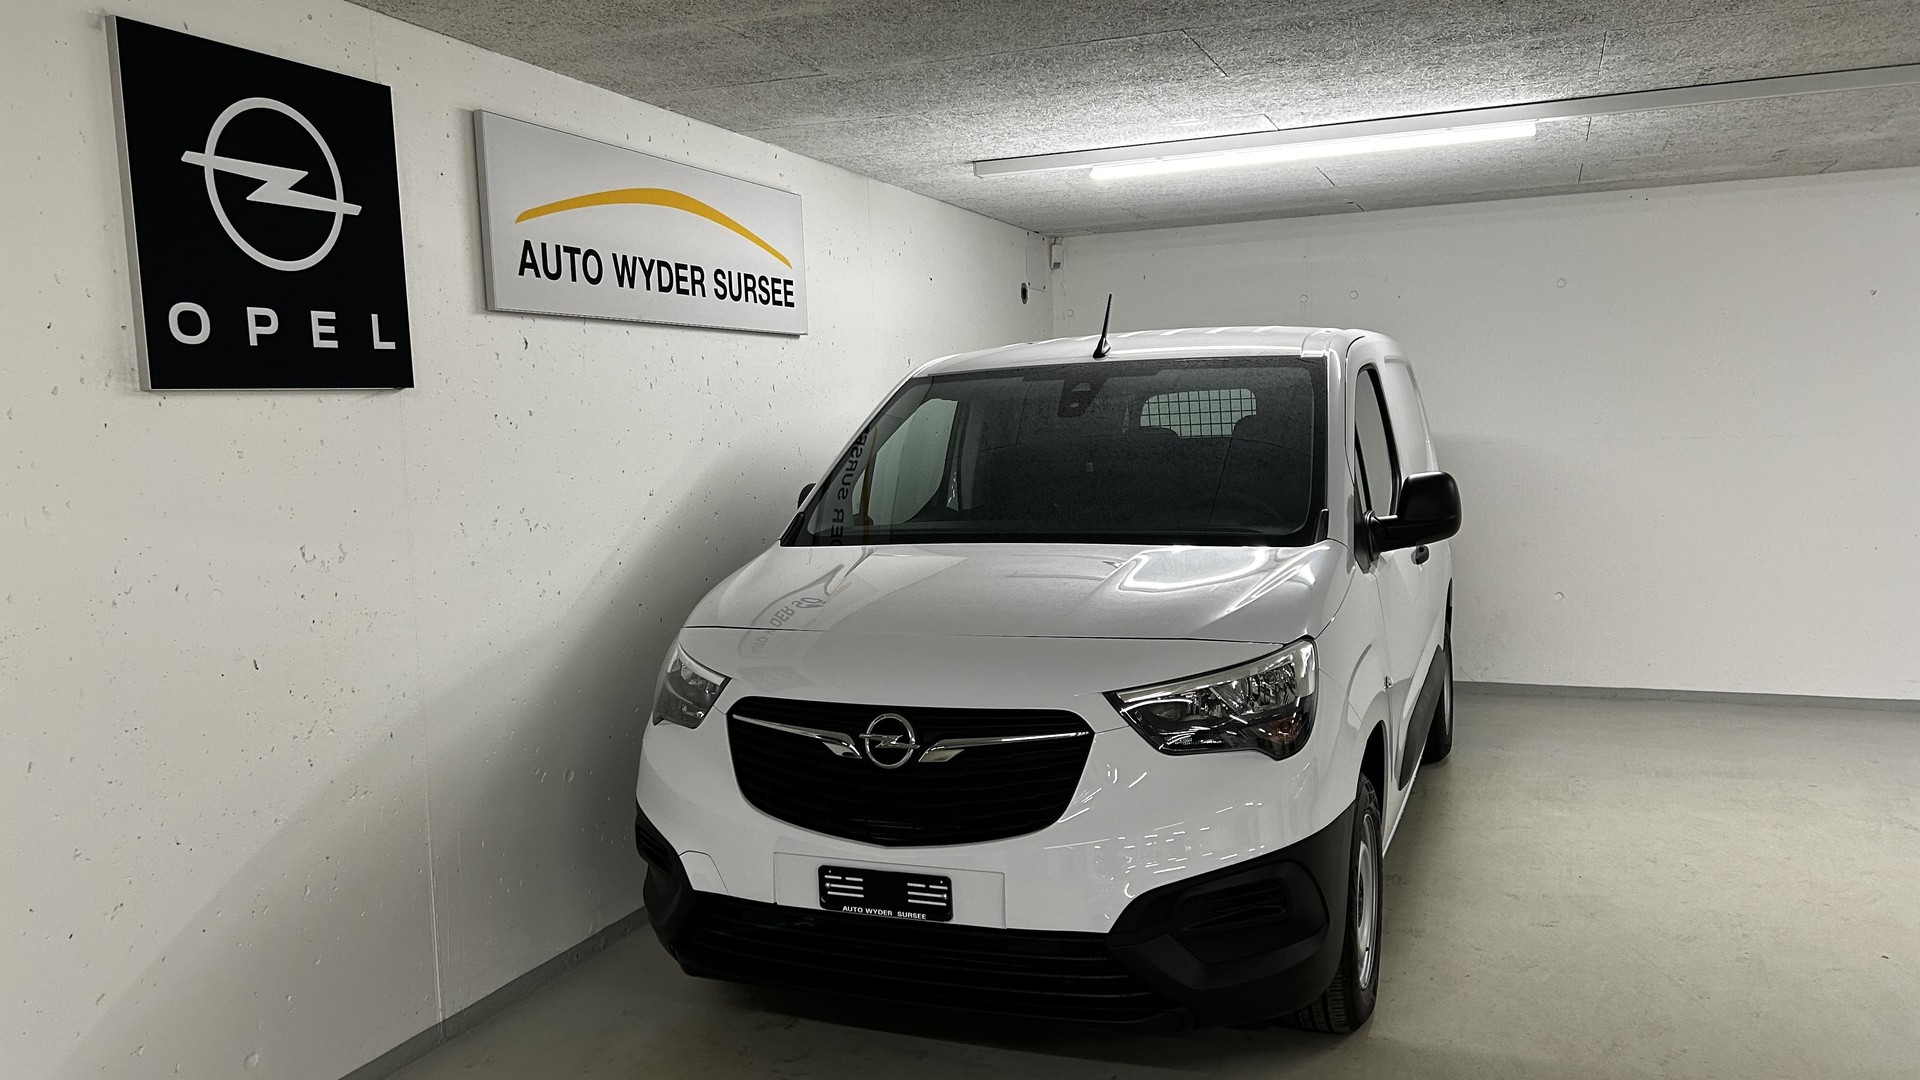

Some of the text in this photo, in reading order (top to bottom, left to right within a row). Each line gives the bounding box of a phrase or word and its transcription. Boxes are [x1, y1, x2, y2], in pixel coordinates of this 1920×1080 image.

[518, 240, 795, 308] AUTO WYDER SURSEE
[168, 302, 396, 350] OPEL
[842, 905, 927, 920] AUTO WYDER SURSEE
